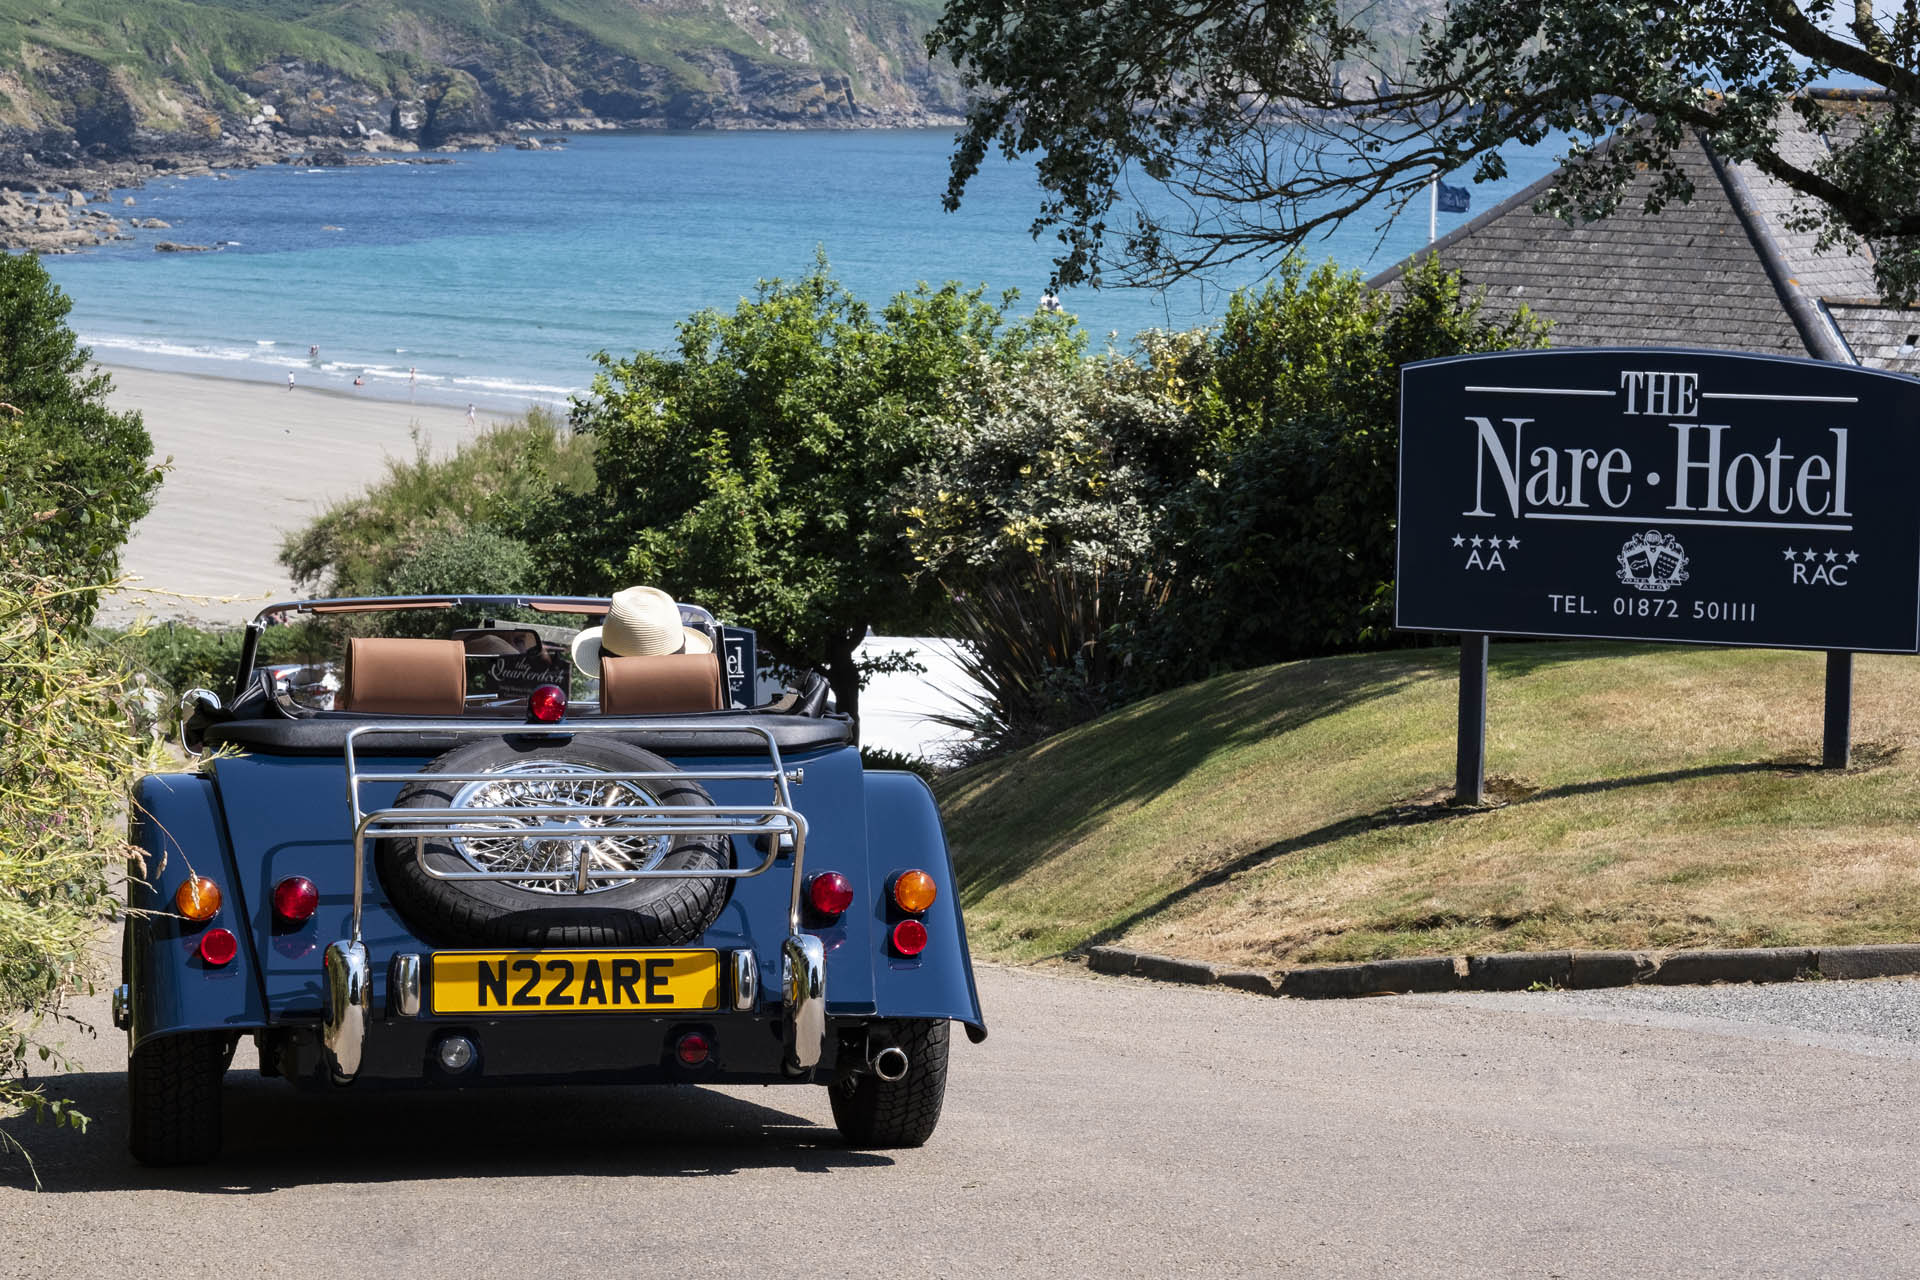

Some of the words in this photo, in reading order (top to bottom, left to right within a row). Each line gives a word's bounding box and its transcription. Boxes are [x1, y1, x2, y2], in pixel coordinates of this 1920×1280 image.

[1620, 370, 1699, 417] THE
[1463, 416, 1632, 518] Nare
[1665, 423, 1853, 517] Hotel
[1465, 549, 1506, 572] AA
[1793, 563, 1849, 586] RAC
[1548, 594, 1598, 614] TEL.
[1613, 597, 1679, 618] 01872
[1692, 600, 1756, 622] 501111
[478, 958, 675, 1007] N22ARE
